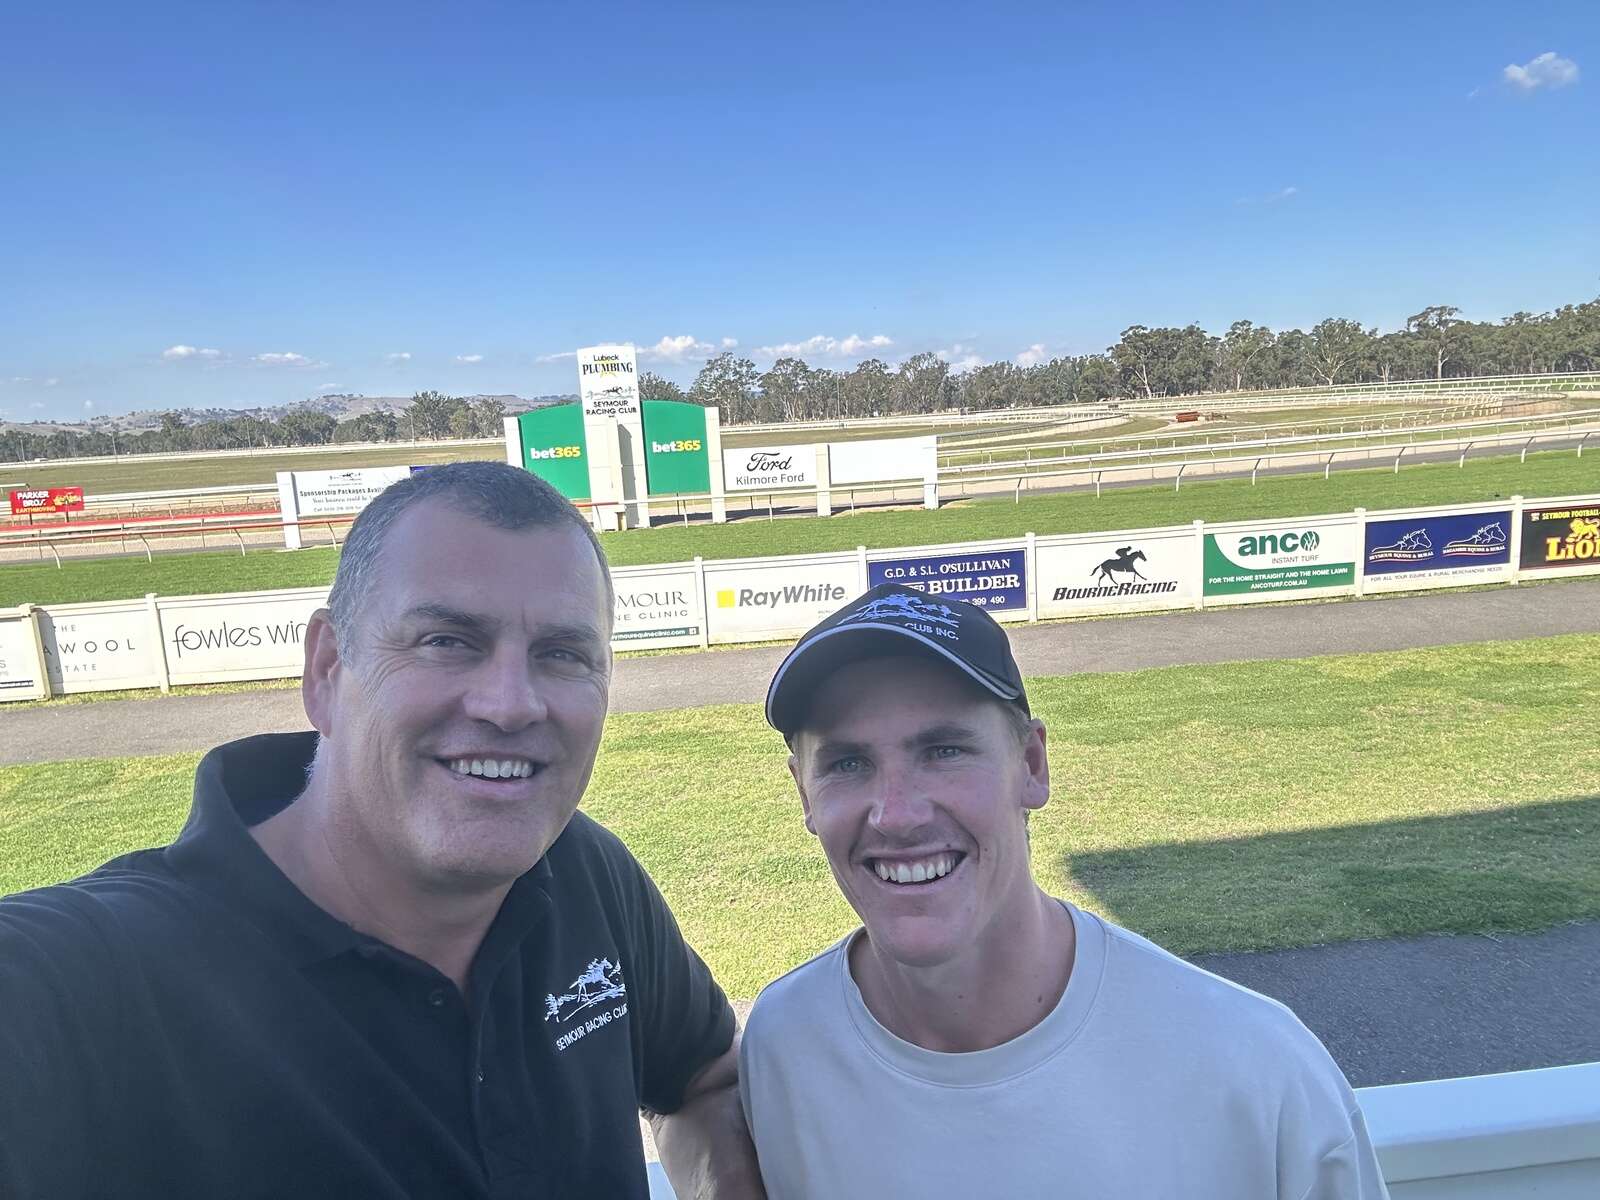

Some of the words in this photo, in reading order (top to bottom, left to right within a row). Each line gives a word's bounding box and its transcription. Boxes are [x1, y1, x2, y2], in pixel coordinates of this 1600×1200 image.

[582, 362, 633, 375] PLUMBING
[593, 400, 629, 408] SEYMOUR
[618, 406, 637, 414] CLUB
[530, 446, 581, 459] bet365
[652, 440, 701, 453] bet365
[746, 452, 792, 471] Ford
[736, 475, 778, 486] Kilmore
[780, 472, 805, 483] Ford
[16, 490, 49, 500] PARKER
[299, 487, 337, 498] Sponsorship
[337, 486, 366, 497] Packages
[15, 506, 56, 514] EARTHMOVING
[1542, 511, 1570, 520] SEYMOUR
[1237, 531, 1320, 556] anco
[1271, 556, 1298, 564] INSTANT
[1301, 554, 1319, 562] TURF
[884, 567, 907, 578] G.D.
[909, 566, 918, 577] &
[920, 565, 938, 576] S.L.
[940, 558, 1011, 574] O'SULLIVAN
[1209, 577, 1221, 585] FOR
[1235, 574, 1254, 582] HOME
[1254, 572, 1285, 580] STRAIGHT
[1312, 568, 1329, 576] HOME
[1330, 567, 1348, 575] LAWN
[927, 573, 1021, 595] BUILDER
[1250, 579, 1308, 590] ANCOTURF.COM.AU
[617, 591, 689, 608] MOUR
[972, 597, 987, 606] 399
[990, 596, 1006, 605] 490
[638, 610, 688, 619] CLINIC
[904, 622, 933, 634] CLUB
[935, 626, 960, 641] INC.
[172, 620, 262, 658] fowles
[266, 620, 307, 645] win
[42, 639, 136, 656] AWOOL
[556, 1025, 586, 1051] SEYMOUR
[584, 1011, 613, 1033] RACING
